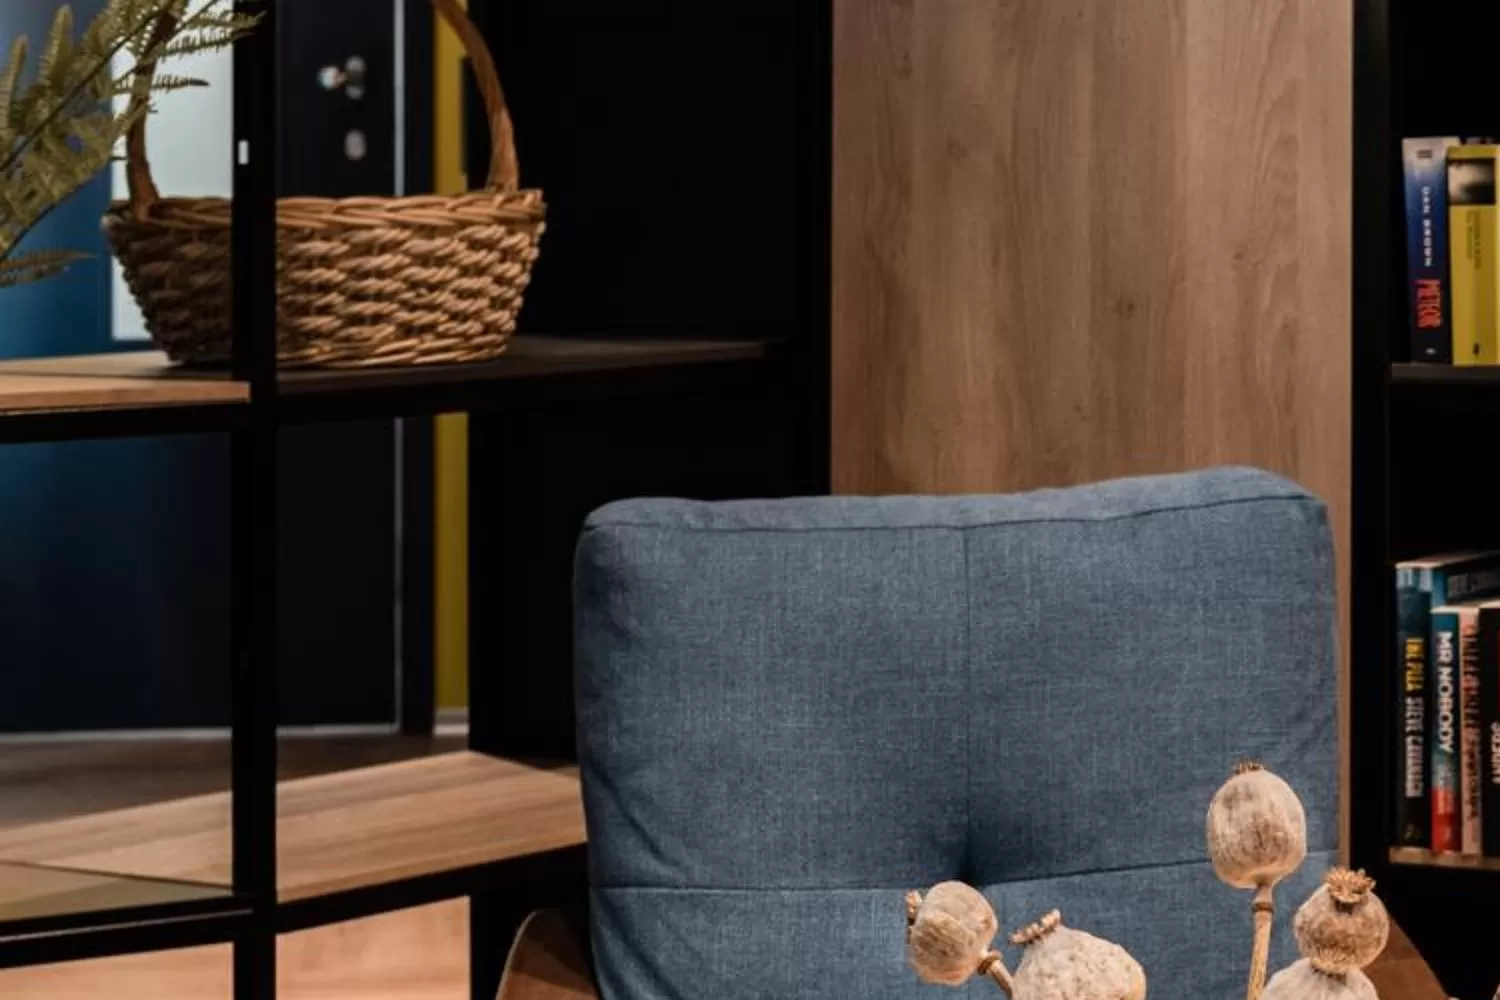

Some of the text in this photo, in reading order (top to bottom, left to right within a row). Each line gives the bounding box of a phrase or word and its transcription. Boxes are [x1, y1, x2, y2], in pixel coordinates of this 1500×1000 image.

[1416, 279, 1442, 329] METEOR
[1405, 637, 1424, 692] THE PLEA
[1405, 696, 1424, 733] STEVE
[1438, 631, 1454, 754] MR NOBODY
